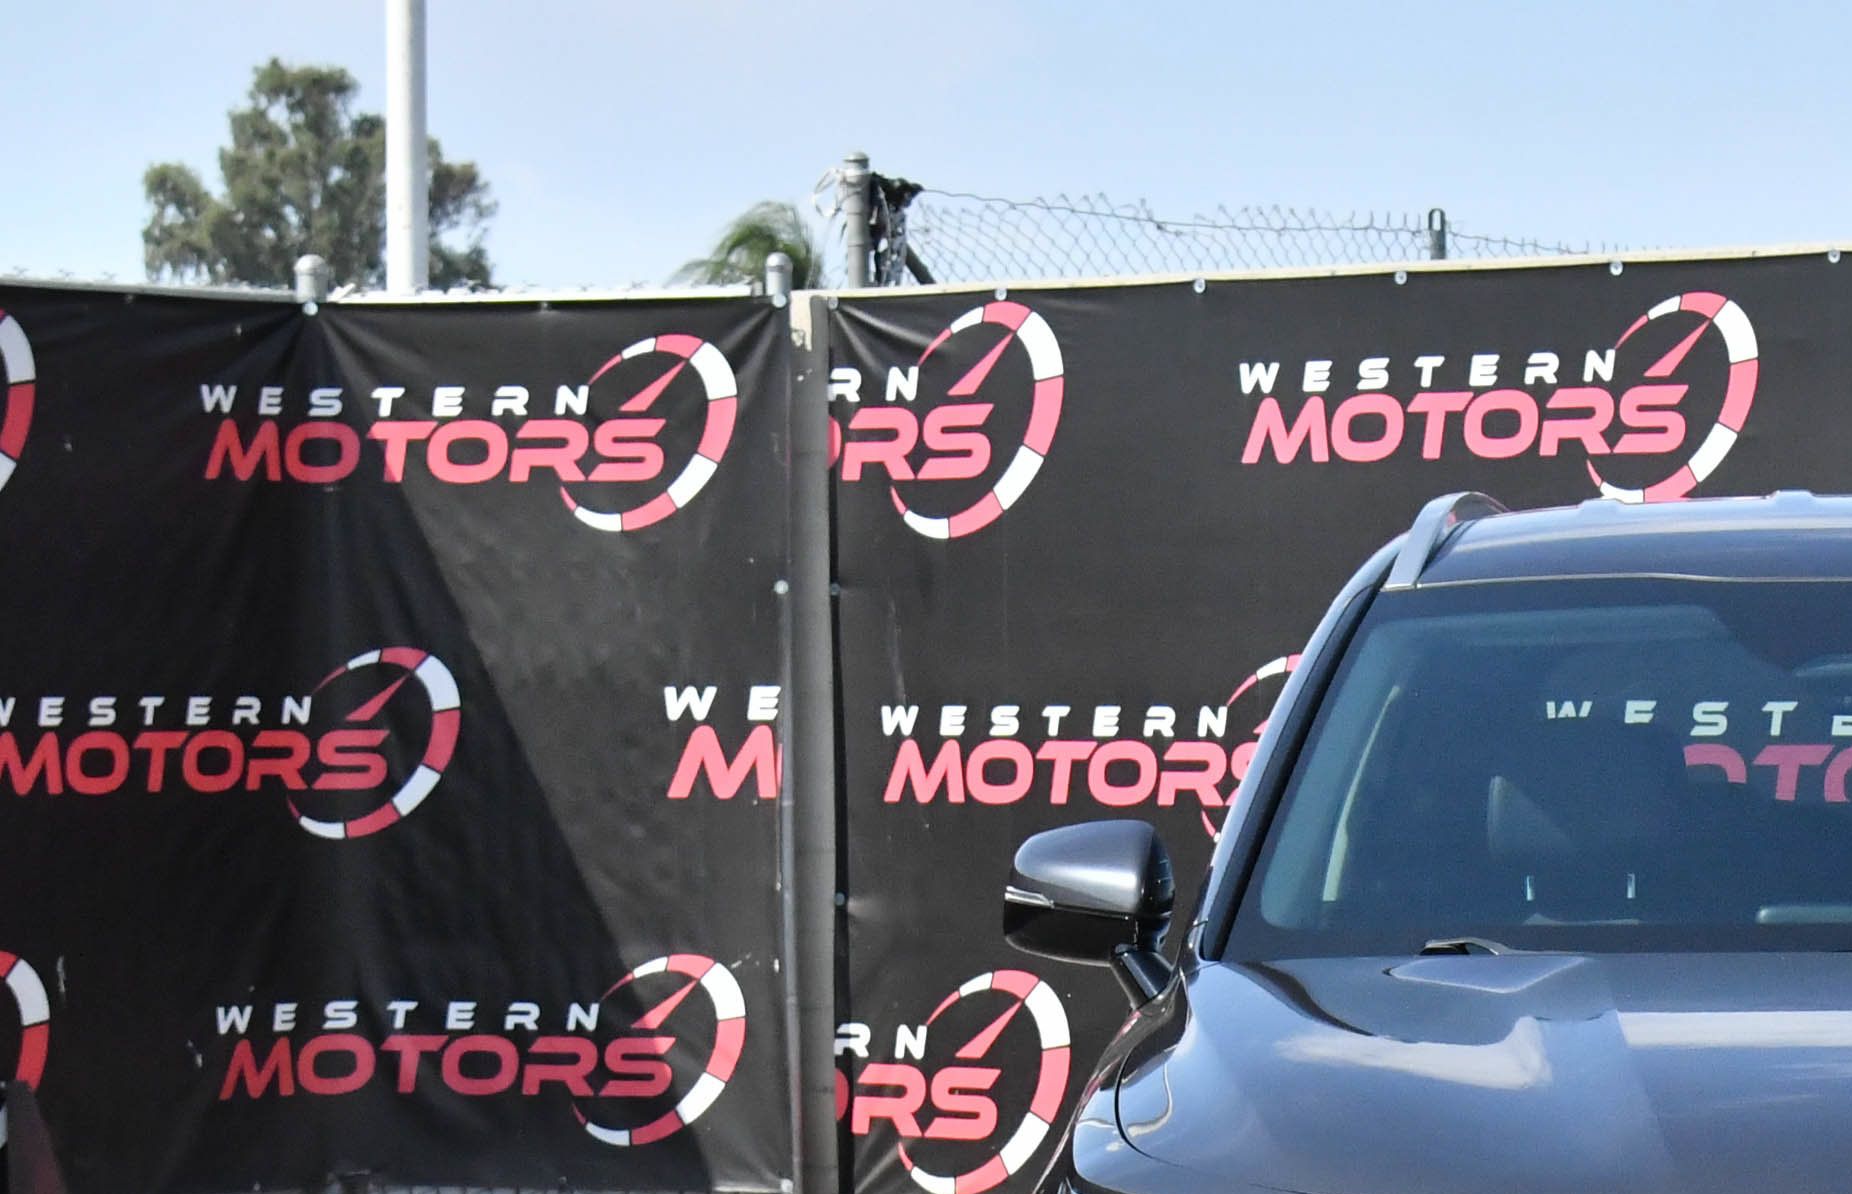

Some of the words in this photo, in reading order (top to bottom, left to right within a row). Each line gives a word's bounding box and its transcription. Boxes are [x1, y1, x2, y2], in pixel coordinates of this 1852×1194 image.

[201, 383, 589, 417] WESTERN
[1239, 349, 1616, 394] WESTERN
[204, 418, 666, 483] MOTORS
[827, 403, 994, 482] RS
[1241, 384, 1689, 464] MOTORS
[881, 705, 1228, 737] WESTERN
[0, 729, 389, 796] MOTORS
[667, 725, 783, 799] M
[884, 738, 1259, 807] MOTOR
[216, 1000, 599, 1035] WESTERN
[219, 1033, 676, 1101] MOTORS
[834, 1063, 1001, 1140] RS
